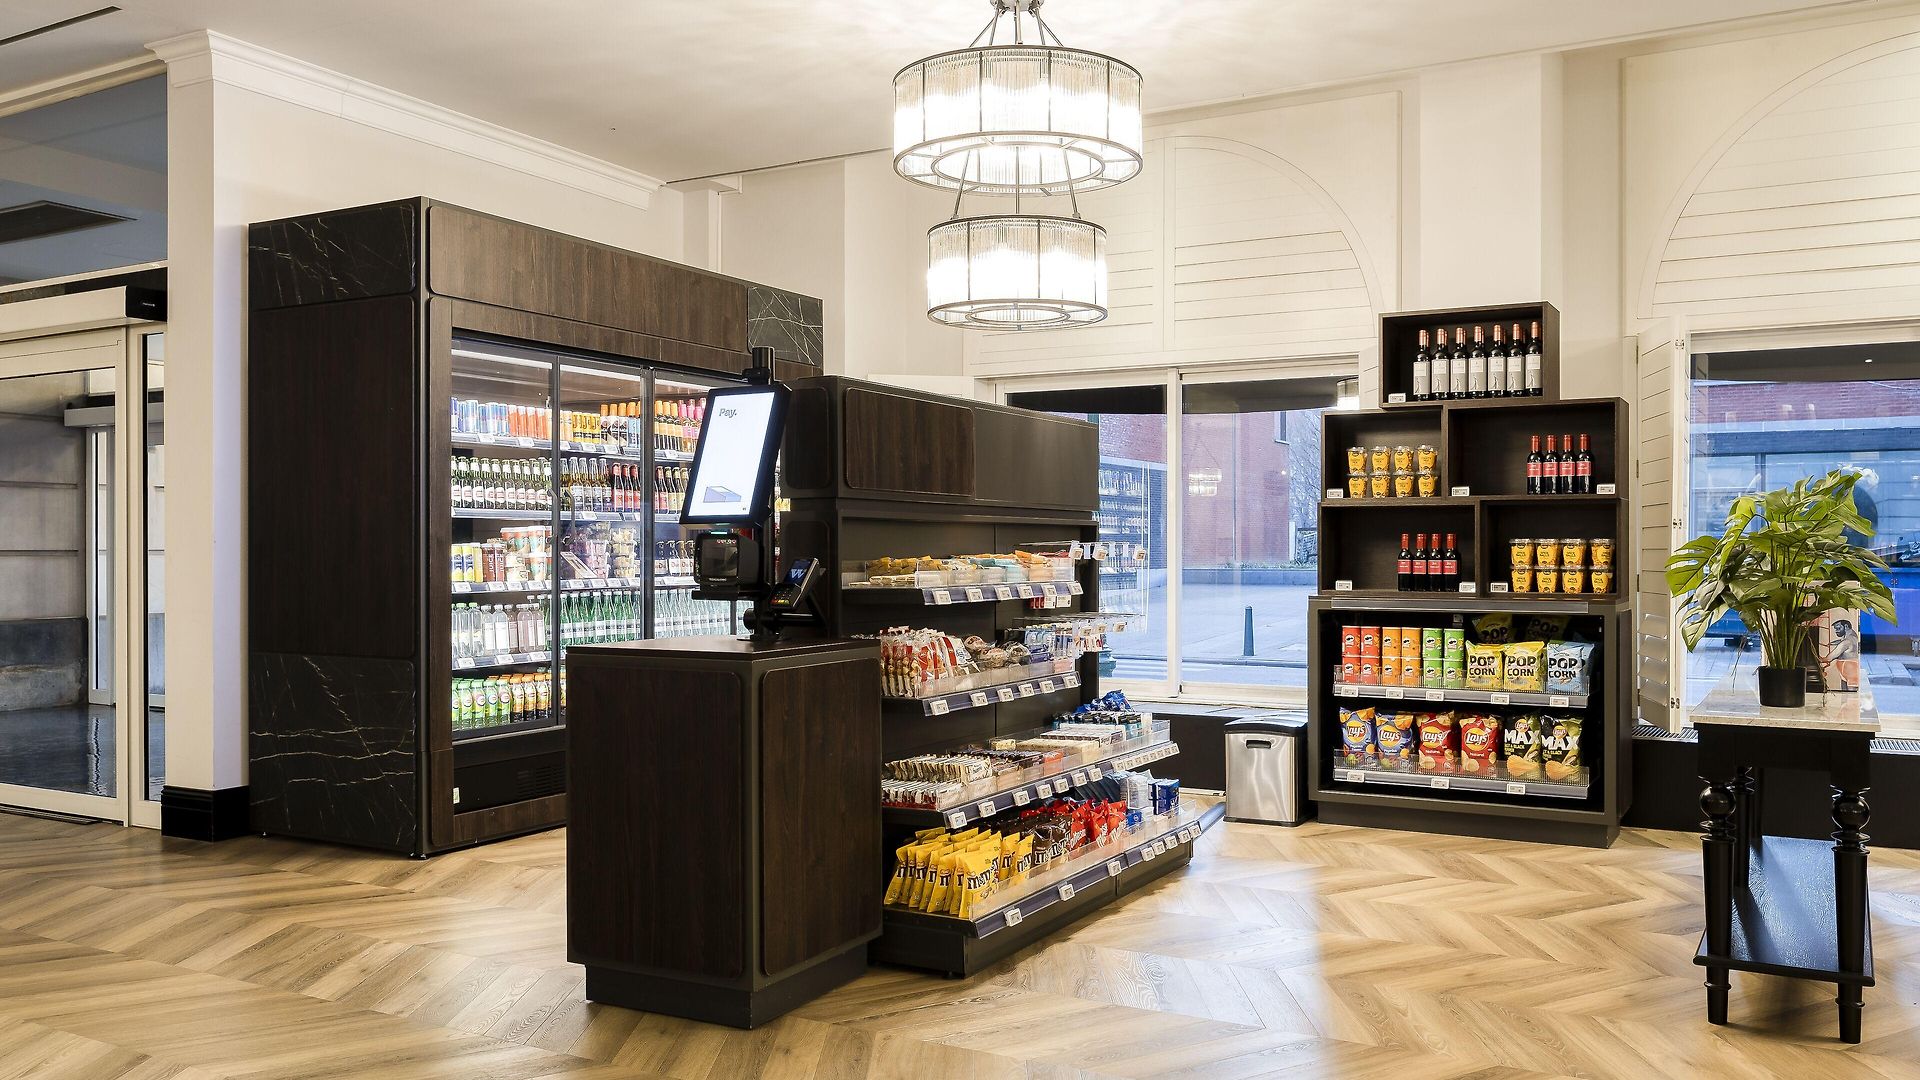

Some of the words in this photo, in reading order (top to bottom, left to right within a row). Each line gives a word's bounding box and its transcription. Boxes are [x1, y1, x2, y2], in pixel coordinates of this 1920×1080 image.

[719, 408, 737, 418] Pay.
[1469, 656, 1495, 666] POP
[1507, 655, 1536, 666] POP
[1548, 657, 1578, 669] POP
[1469, 667, 1496, 676] CORN
[1507, 668, 1535, 676] CORN
[1548, 670, 1576, 678] CORN
[1504, 728, 1540, 745] MAX
[1541, 734, 1580, 751] MAX
